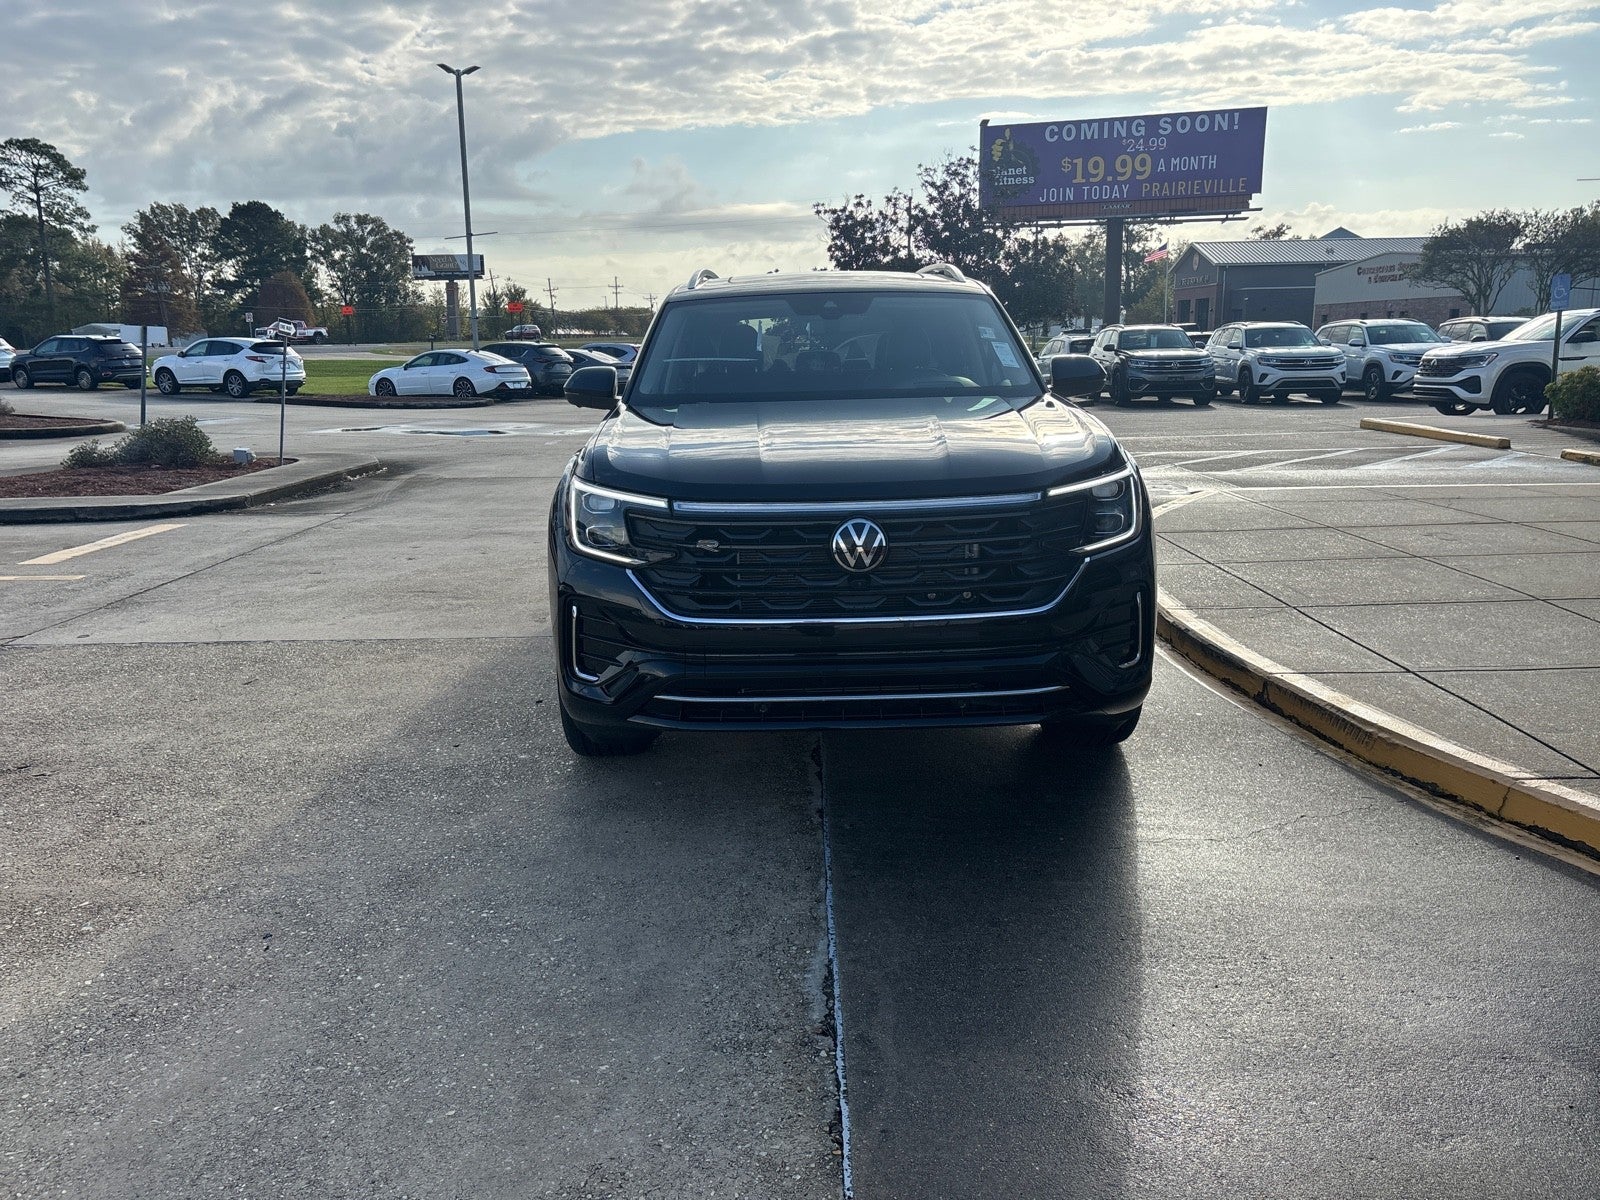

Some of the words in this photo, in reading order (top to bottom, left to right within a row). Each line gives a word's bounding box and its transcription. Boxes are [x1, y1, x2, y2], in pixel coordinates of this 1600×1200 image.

[1044, 119, 1146, 142] COMING
[1158, 112, 1240, 135] SOON!
[1122, 137, 1167, 152] $24.99
[1061, 153, 1152, 183] $19.99
[1157, 158, 1166, 172] A
[1170, 155, 1217, 172] MONTH
[995, 176, 1035, 186] itness
[1040, 187, 1074, 202] JOIN
[1082, 184, 1129, 200] TODAY
[1142, 177, 1247, 197] PRAIRIEVILLE
